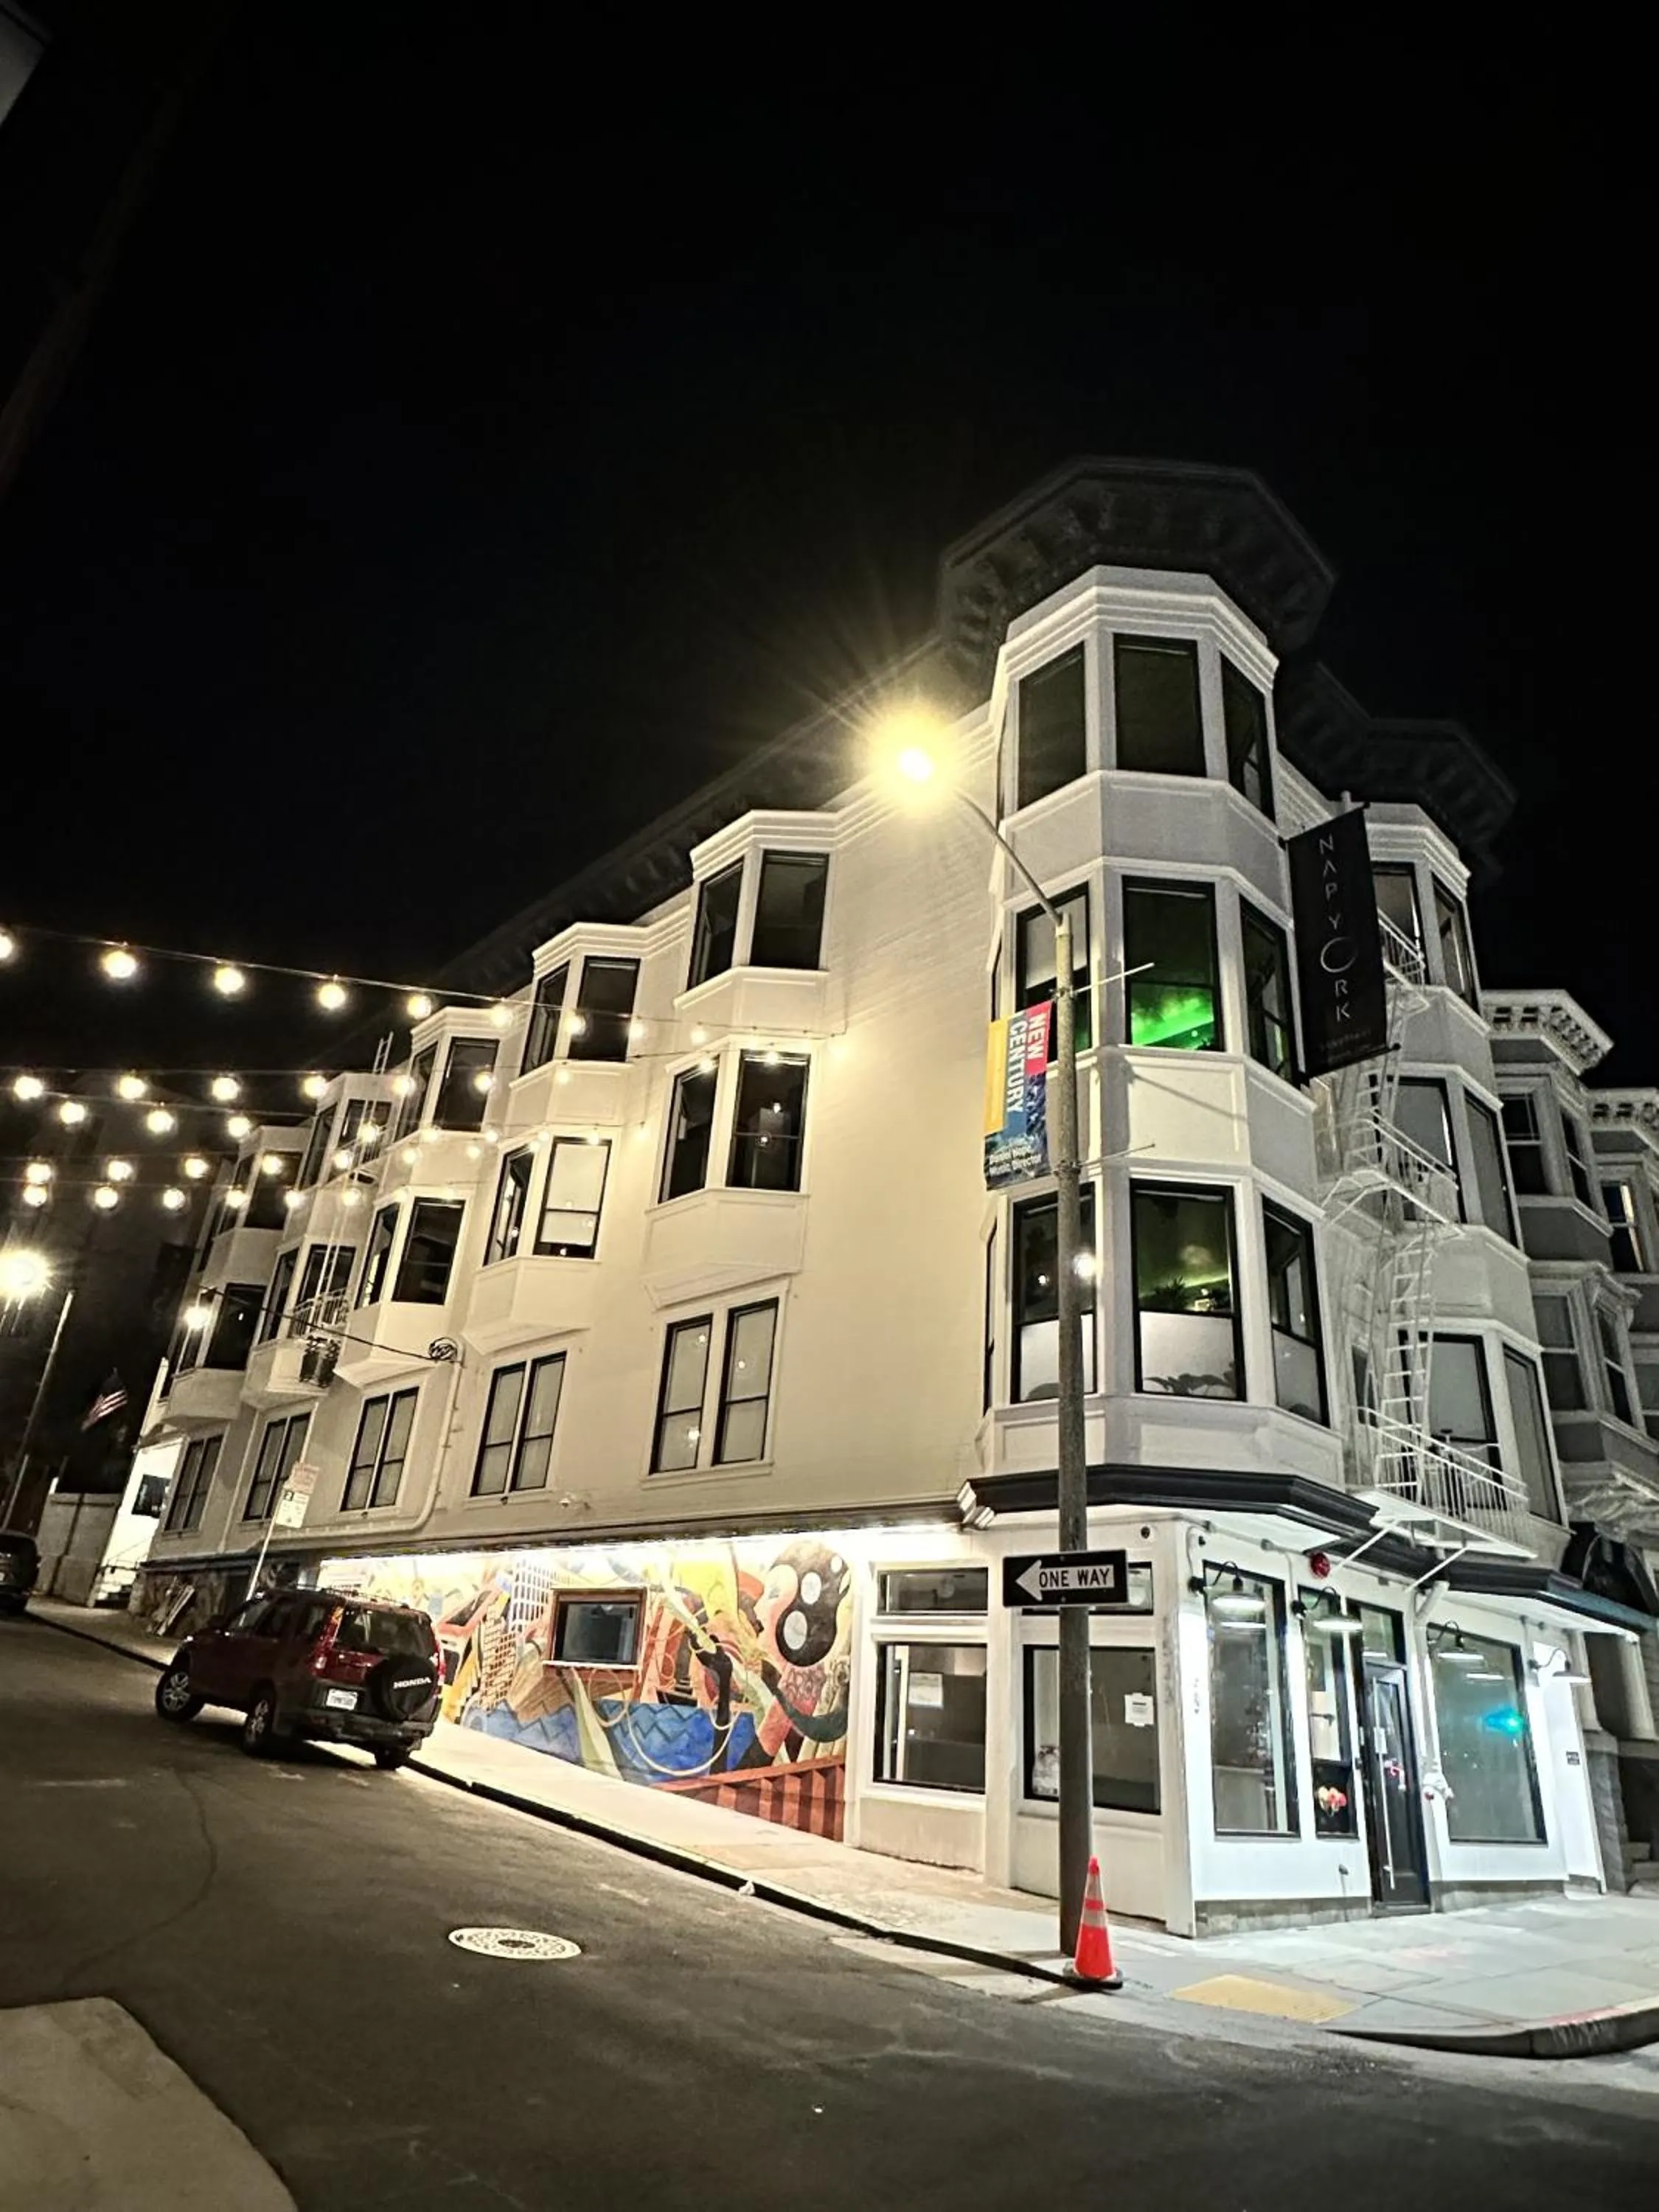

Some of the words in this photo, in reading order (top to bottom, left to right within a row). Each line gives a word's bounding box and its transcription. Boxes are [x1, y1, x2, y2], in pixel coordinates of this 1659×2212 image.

[1028, 1012, 1046, 1059] NEW
[1006, 1022, 1026, 1113] CENTURY
[1039, 1570, 1069, 1587] ONE
[1077, 1568, 1110, 1586] WAY
[393, 1677, 432, 1689] HONDA
